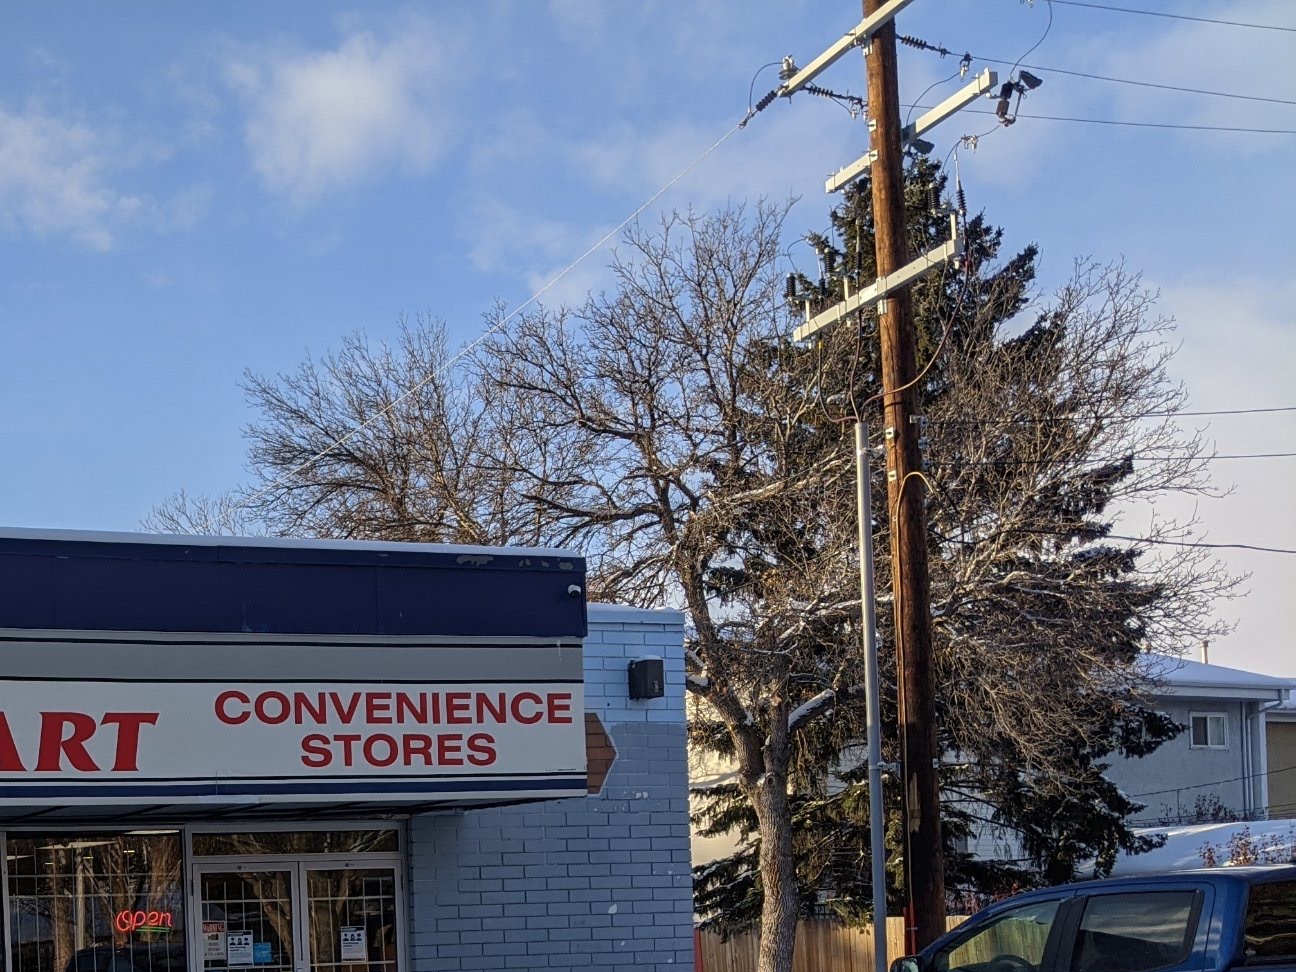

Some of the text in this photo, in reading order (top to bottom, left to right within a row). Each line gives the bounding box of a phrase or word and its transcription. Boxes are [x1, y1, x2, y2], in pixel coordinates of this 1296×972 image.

[214, 690, 572, 725] CONVENIENCE
[300, 732, 497, 768] STORES
[116, 910, 172, 931] Open
